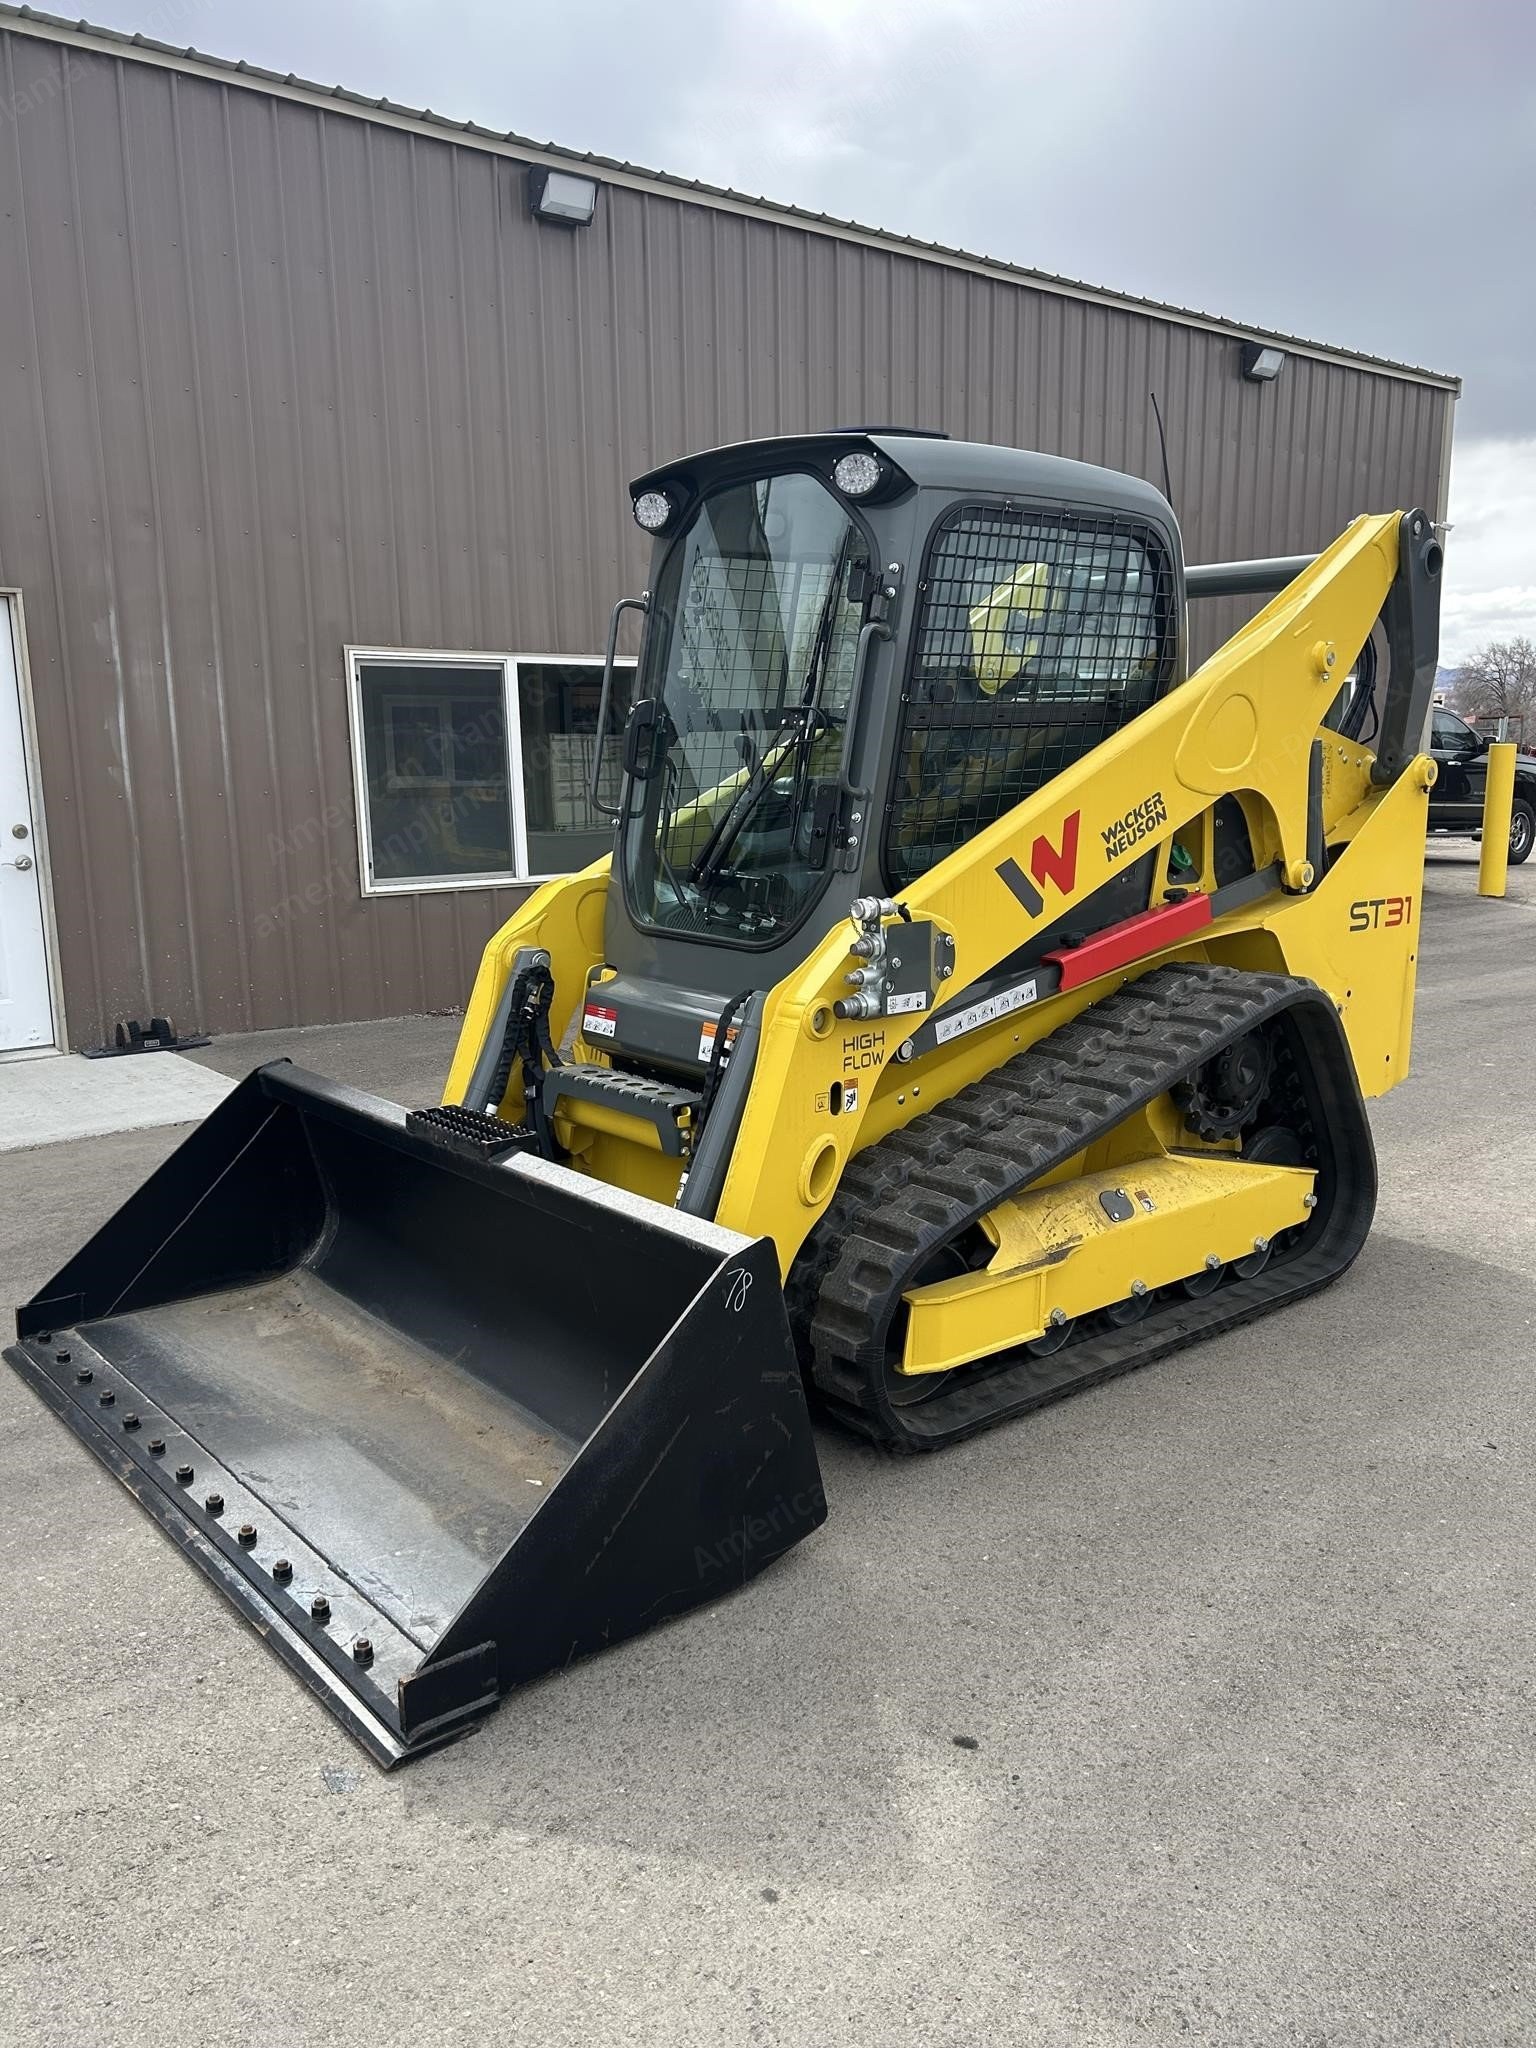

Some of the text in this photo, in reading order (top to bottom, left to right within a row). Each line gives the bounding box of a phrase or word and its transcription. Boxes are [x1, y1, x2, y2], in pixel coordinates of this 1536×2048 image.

[1101, 791, 1165, 844] WACKER
[1105, 806, 1168, 863] NEUSON
[1349, 895, 1412, 932] ST31
[843, 1030, 885, 1053] HIGH
[843, 1049, 885, 1072] FLOW
[725, 1267, 753, 1312] 78
